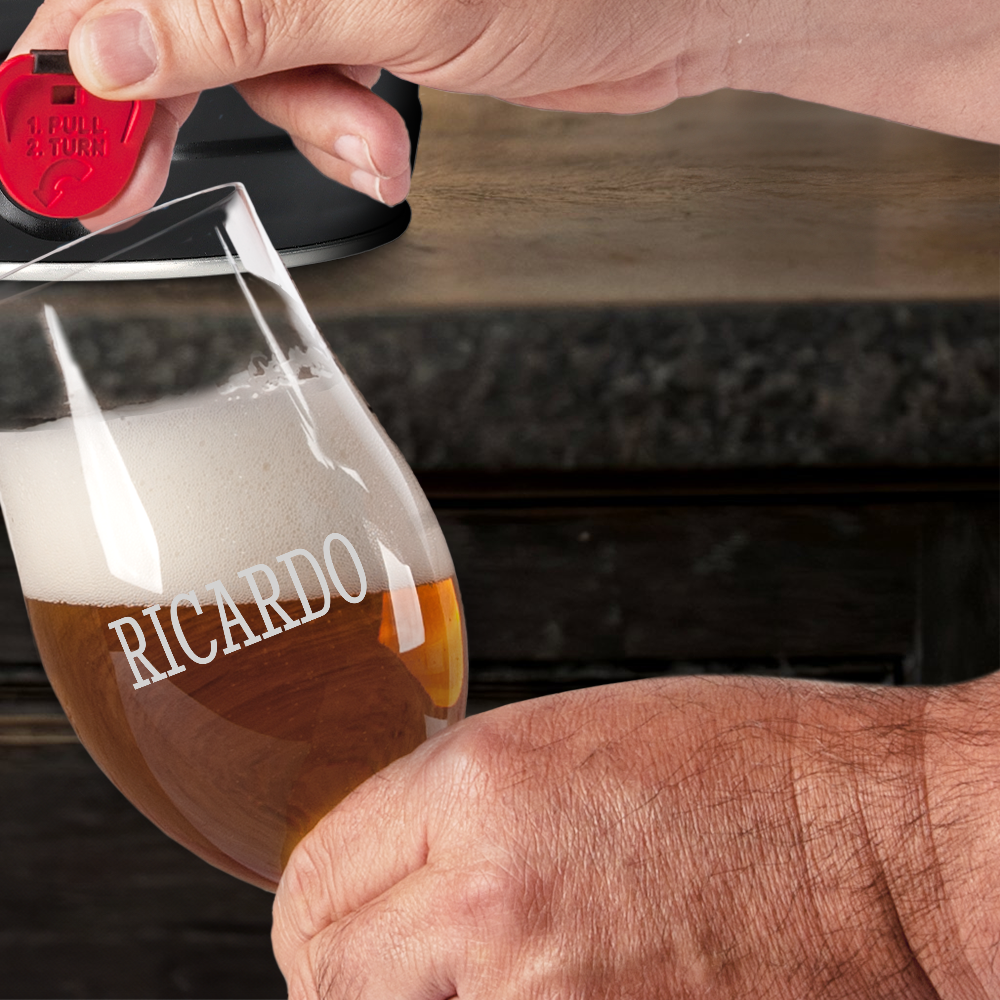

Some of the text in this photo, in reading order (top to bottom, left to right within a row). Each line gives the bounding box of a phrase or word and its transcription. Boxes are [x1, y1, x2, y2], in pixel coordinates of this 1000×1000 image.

[48, 116, 107, 135] PULL
[48, 138, 107, 157] TURN
[108, 532, 368, 690] RICARDO
